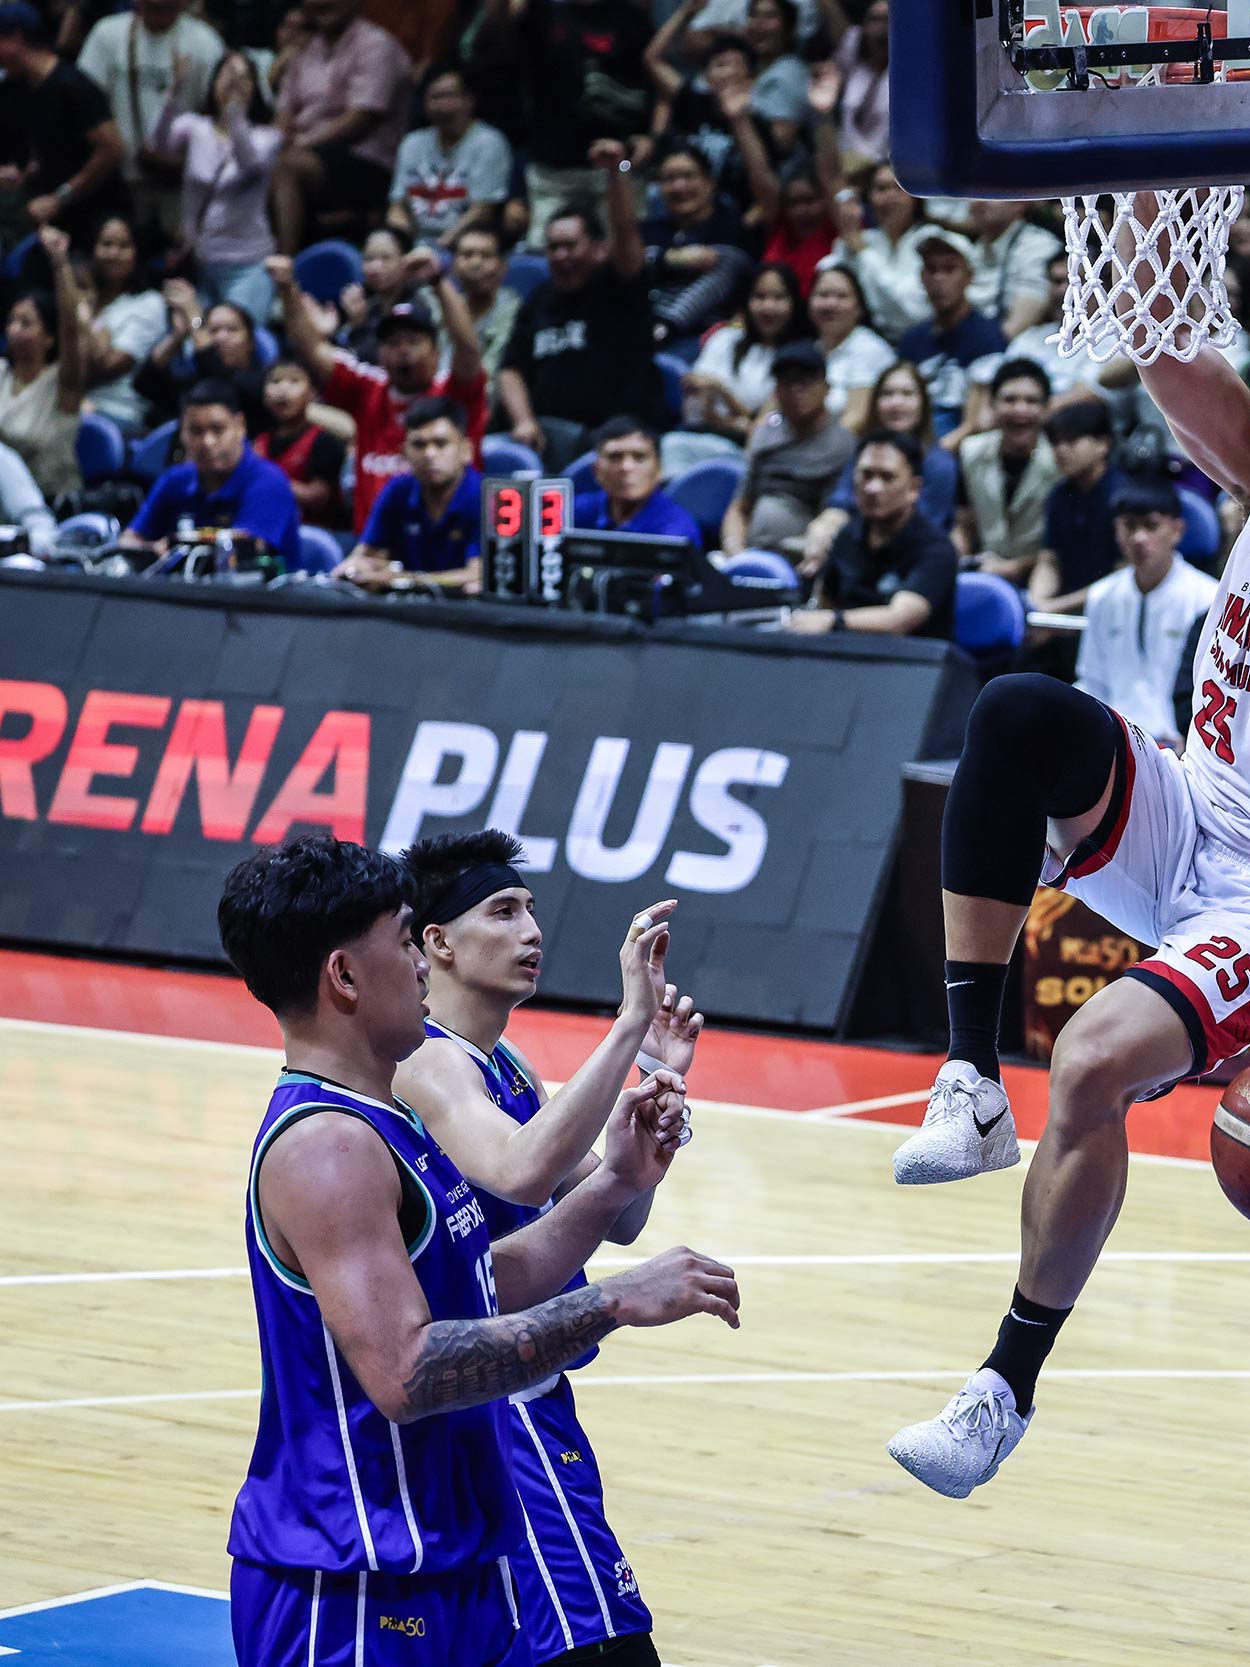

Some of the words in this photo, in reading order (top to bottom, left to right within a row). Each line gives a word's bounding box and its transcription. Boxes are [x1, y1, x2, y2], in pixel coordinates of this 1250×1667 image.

[496, 487, 522, 537] 3
[541, 489, 563, 537] 3
[1194, 679, 1237, 765] 25
[1035, 976, 1108, 1007] SO
[379, 1615, 426, 1638] PBA50
